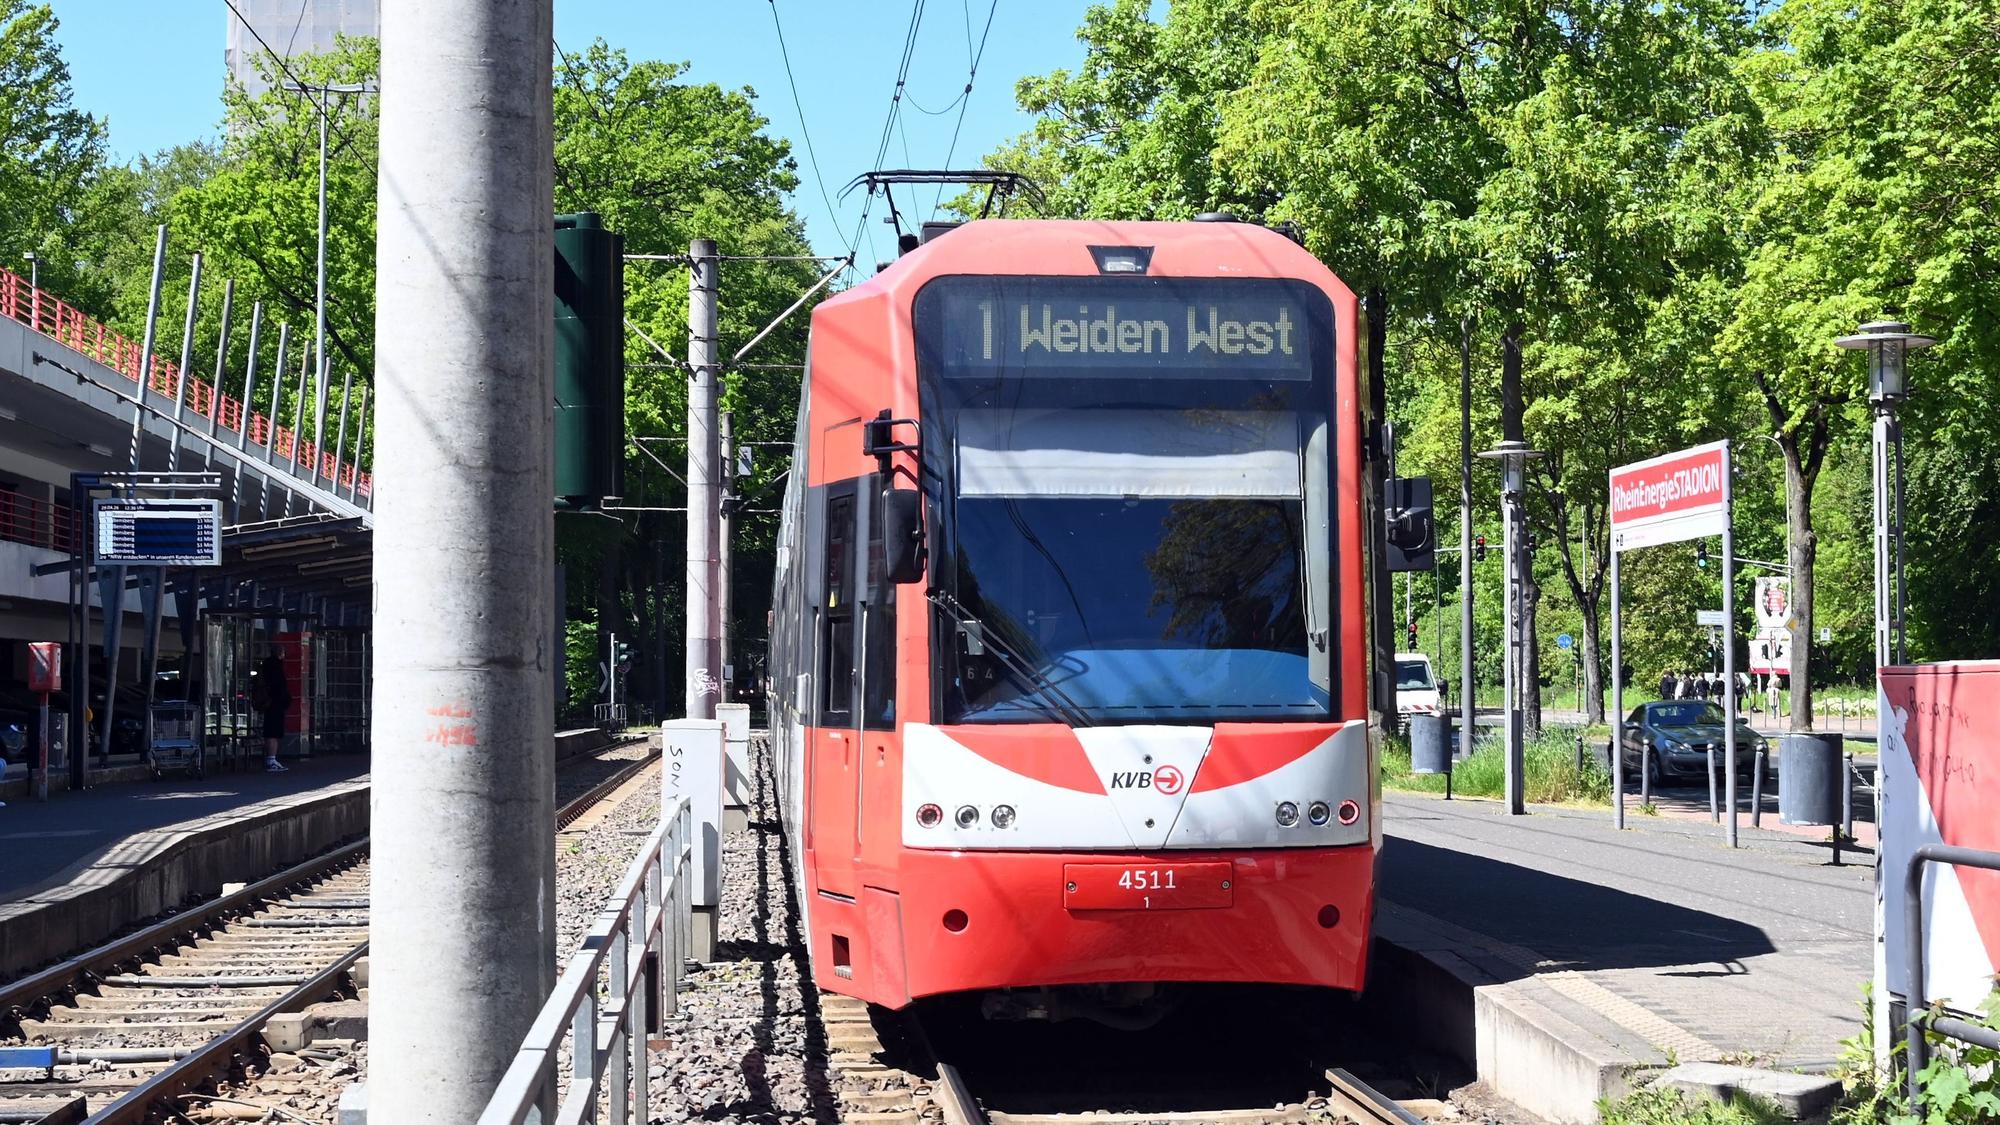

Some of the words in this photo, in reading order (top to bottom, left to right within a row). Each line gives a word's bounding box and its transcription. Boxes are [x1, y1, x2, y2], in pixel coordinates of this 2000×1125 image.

[978, 300, 992, 359] 1
[1020, 304, 1169, 353] Weiden
[1187, 306, 1293, 355] West
[1613, 463, 1720, 511] RheinEnergieSTADION
[667, 745, 683, 800] SONY
[1111, 772, 1152, 789] KVB
[1118, 869, 1177, 890] 4511
[1143, 896, 1150, 909] 1
